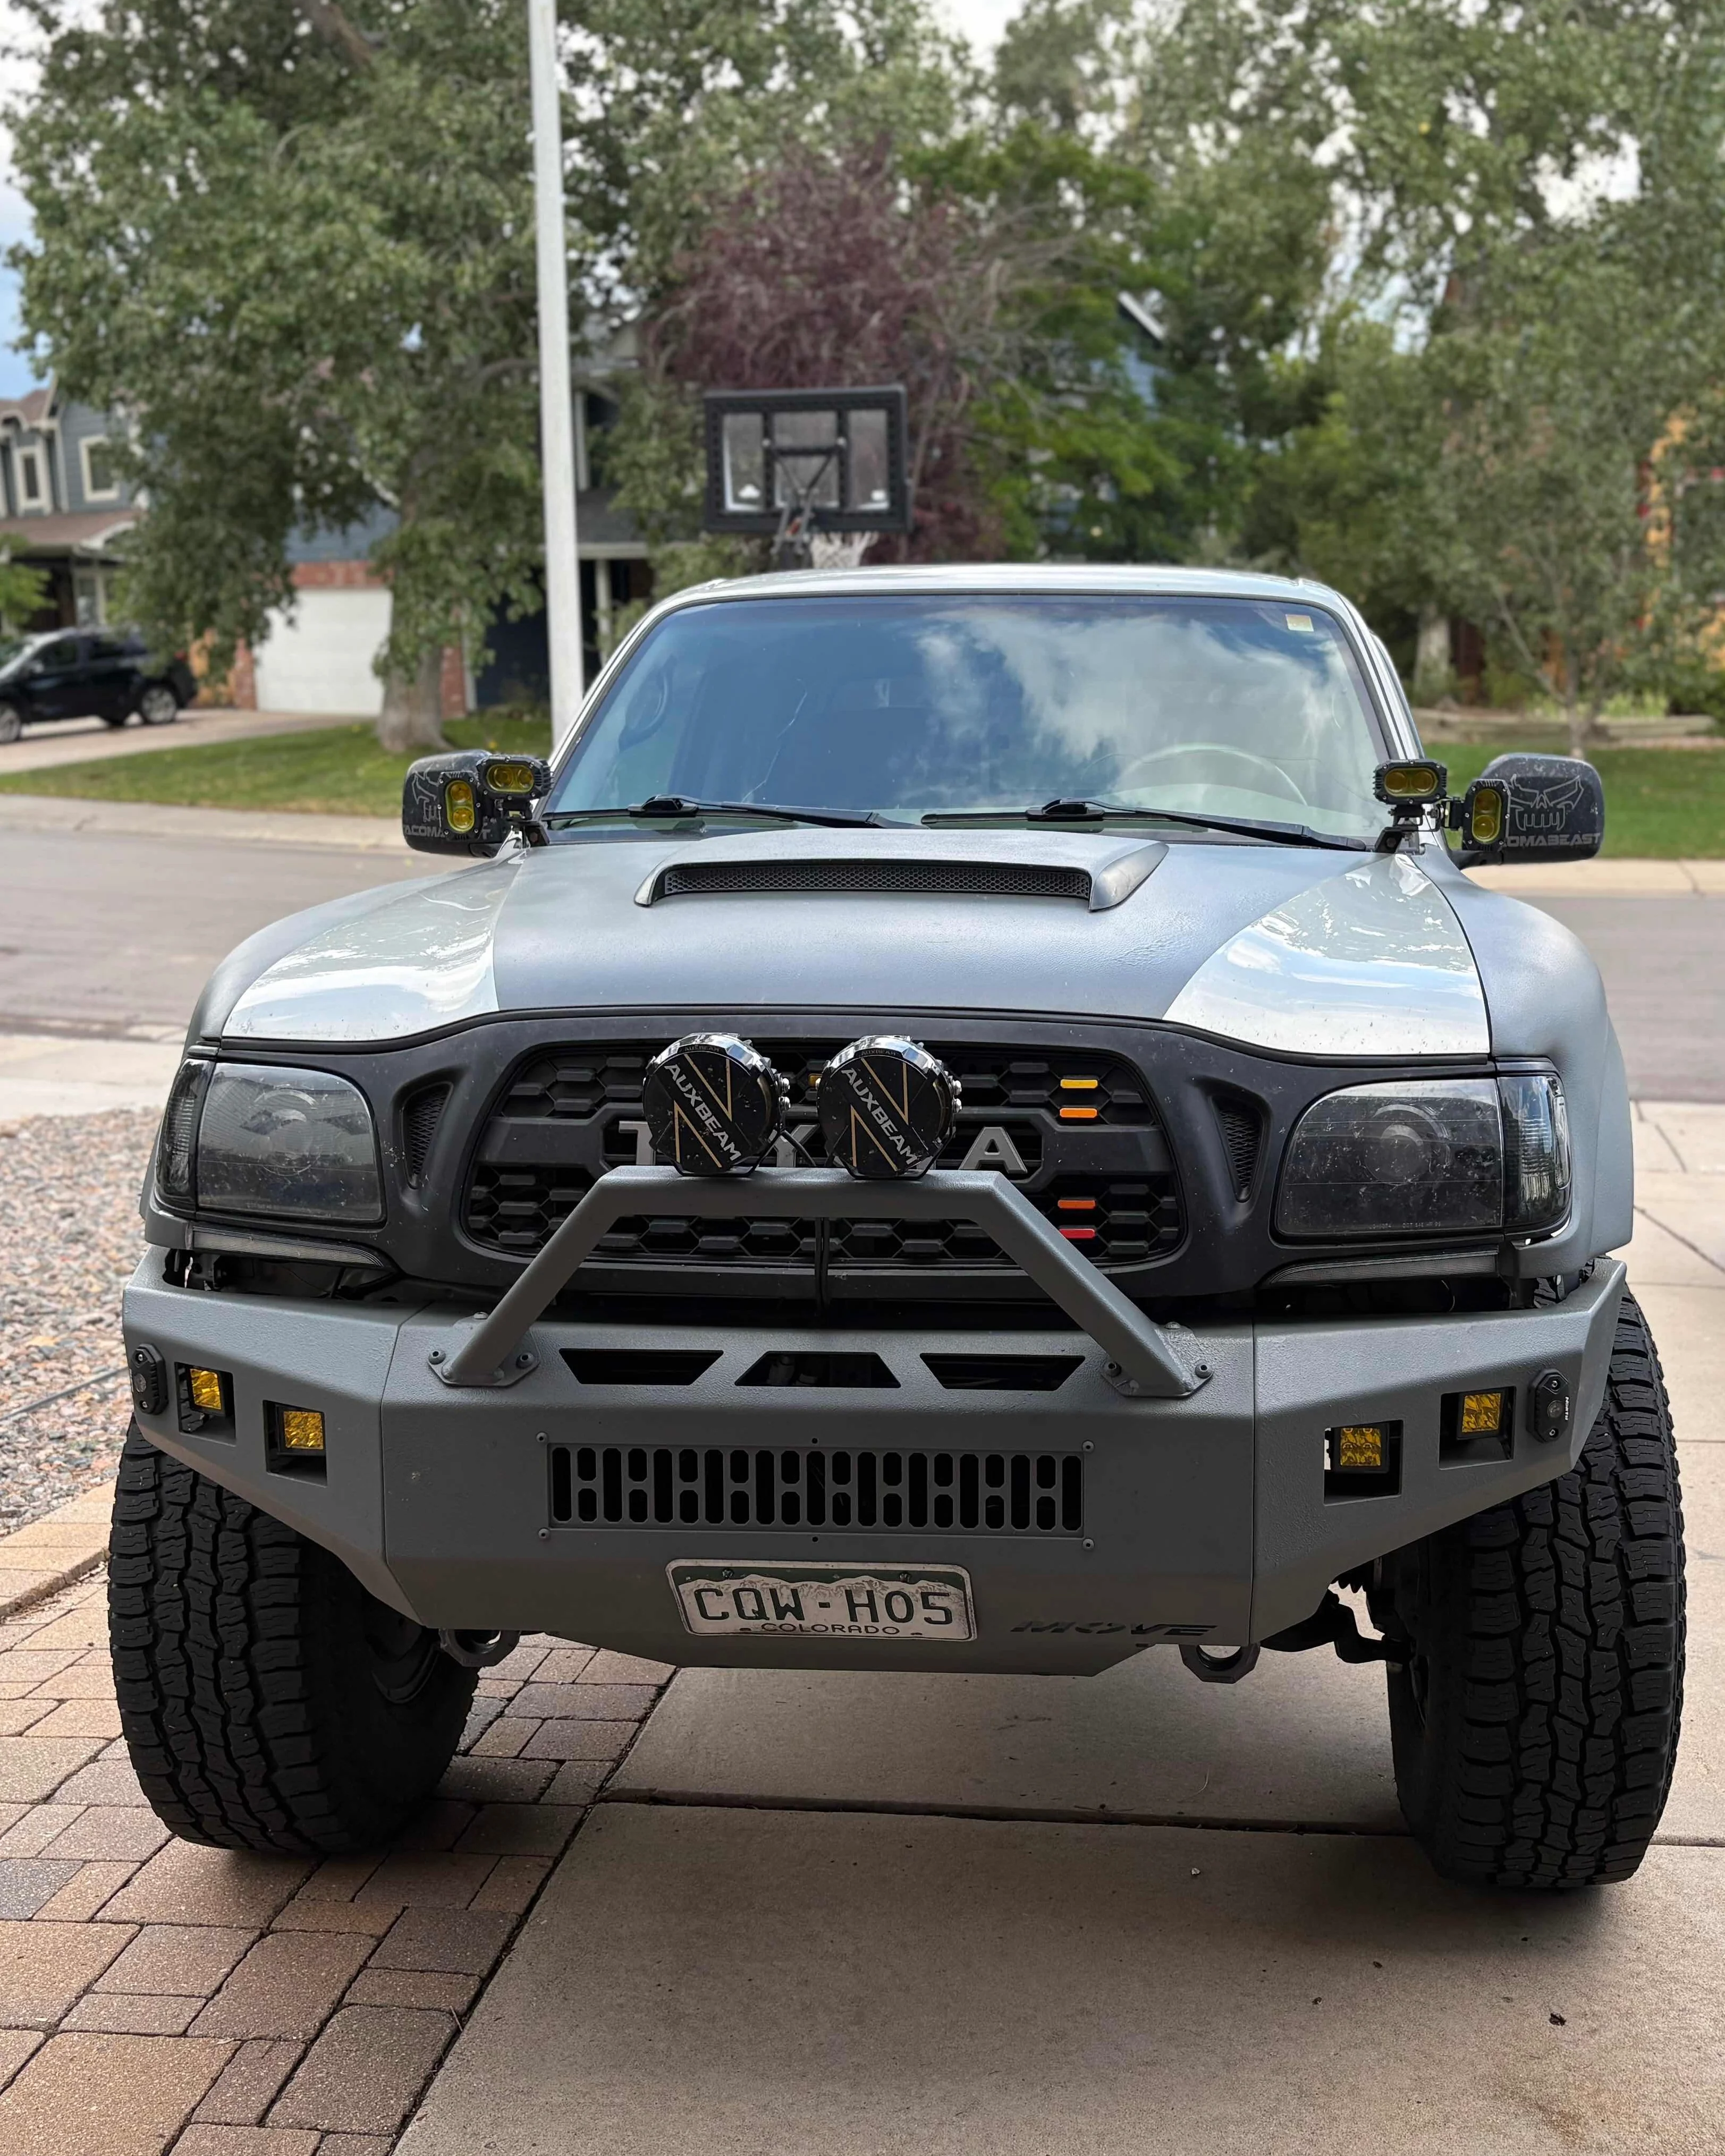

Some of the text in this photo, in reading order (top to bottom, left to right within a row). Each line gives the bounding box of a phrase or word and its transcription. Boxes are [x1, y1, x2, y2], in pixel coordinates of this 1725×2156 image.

[1504, 833, 1601, 847] OMABEAST
[664, 1064, 742, 1161] AUXBEAM
[841, 1067, 918, 1165] AUXBEAM
[761, 1623, 900, 1635] COLORADO
[1010, 1621, 1218, 1636] MOVE
